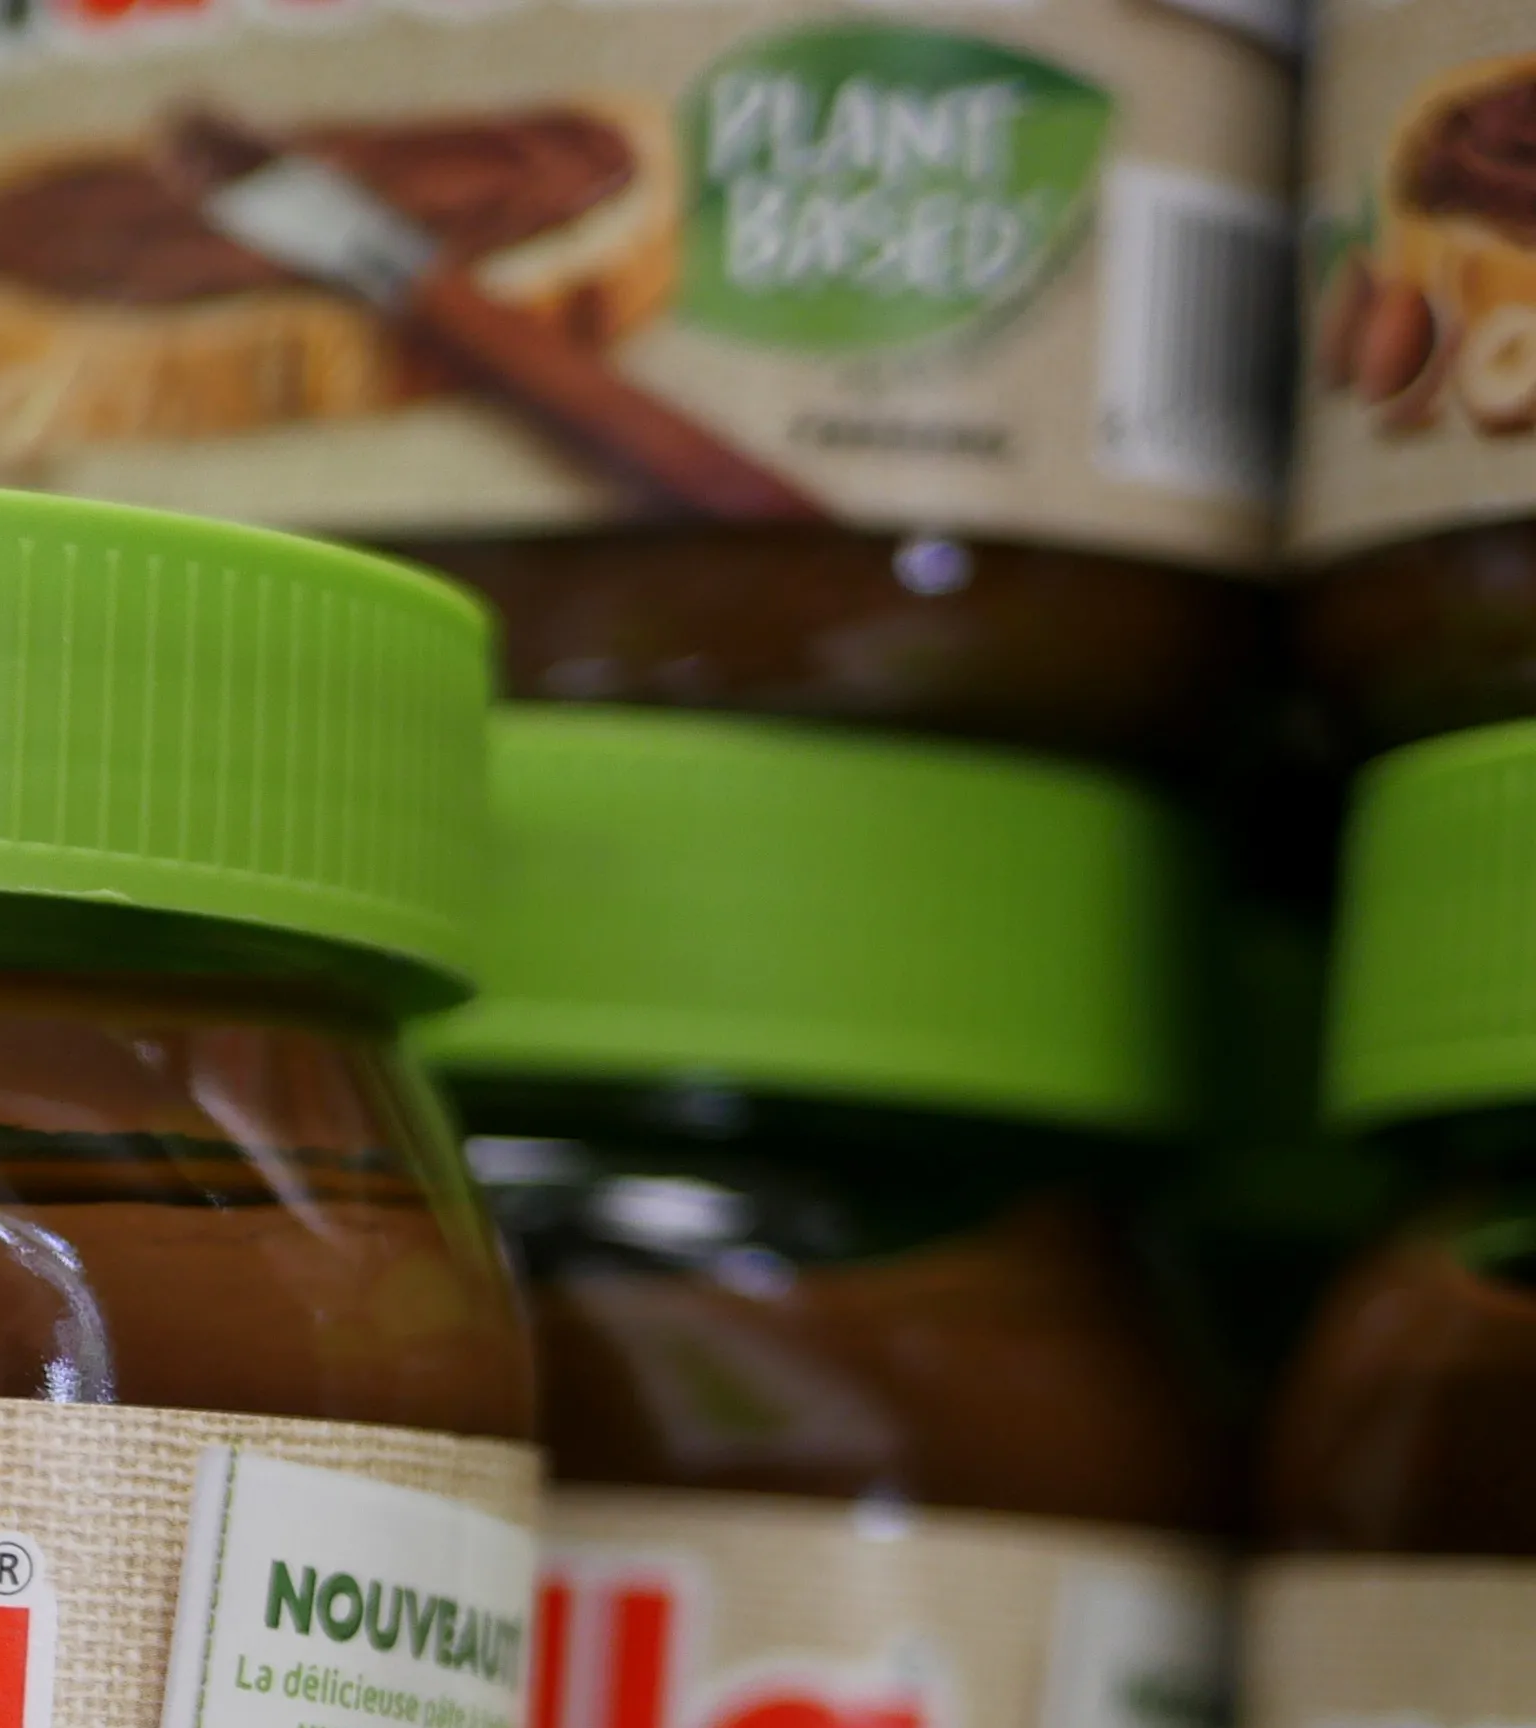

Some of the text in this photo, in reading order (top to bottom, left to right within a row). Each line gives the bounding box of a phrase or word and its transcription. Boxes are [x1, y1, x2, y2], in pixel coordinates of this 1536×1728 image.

[708, 66, 1023, 182] PLANT
[235, 1653, 274, 1694] La
[282, 1661, 421, 1723] délicieuse
